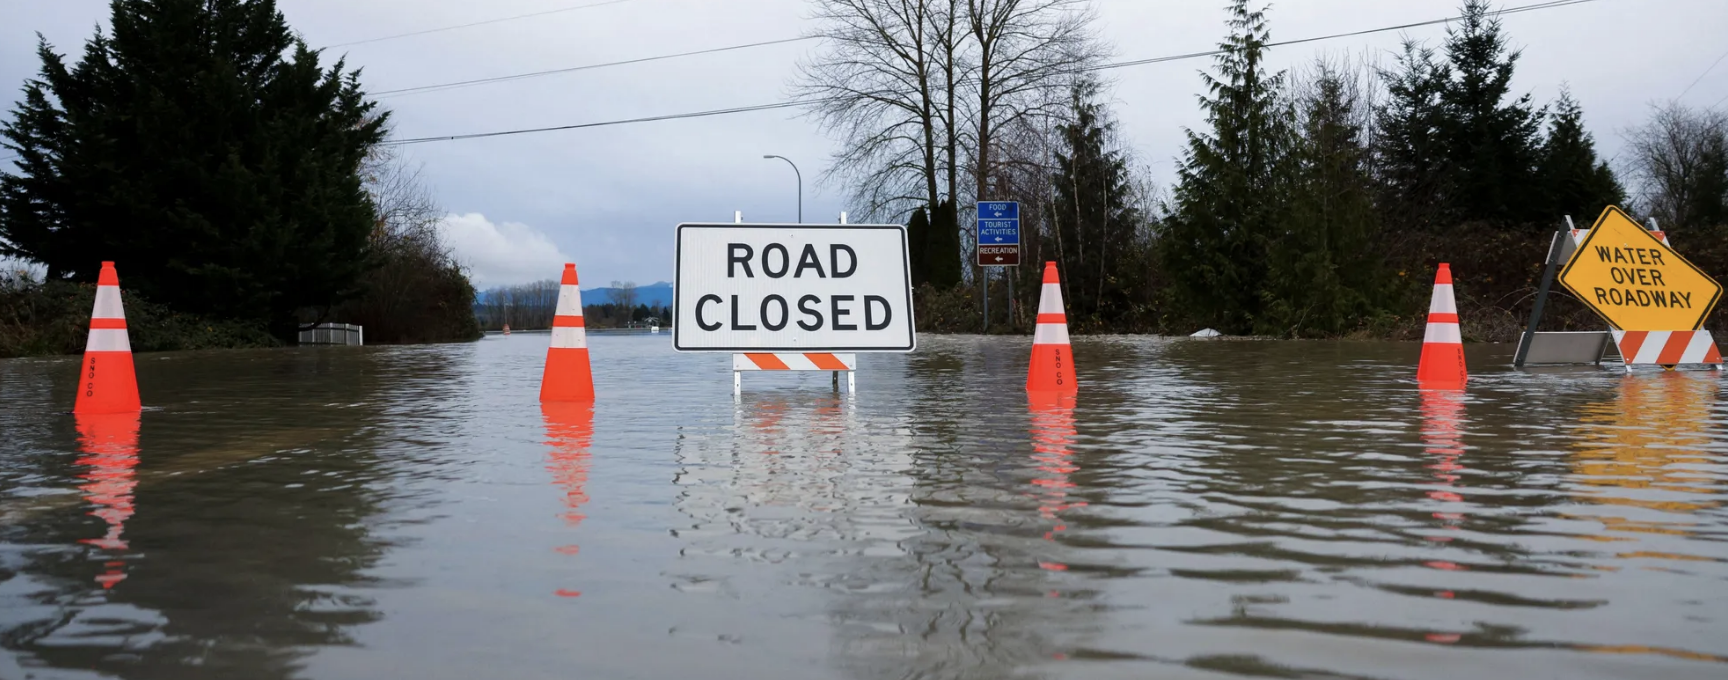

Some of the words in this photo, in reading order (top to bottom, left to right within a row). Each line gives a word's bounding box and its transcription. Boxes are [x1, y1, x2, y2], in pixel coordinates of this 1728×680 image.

[989, 203, 1007, 211] FOOD
[980, 228, 1017, 236] ACTIVITIES
[727, 242, 858, 279] ROAD
[979, 246, 1018, 255] RECREATION
[1595, 245, 1666, 266] WATER
[1610, 266, 1666, 286] OVER
[1594, 287, 1692, 309] ROADWAY
[695, 293, 893, 332] CLOSED
[88, 357, 96, 379] SNO
[1056, 371, 1063, 386] CO
[86, 382, 94, 397] CO
